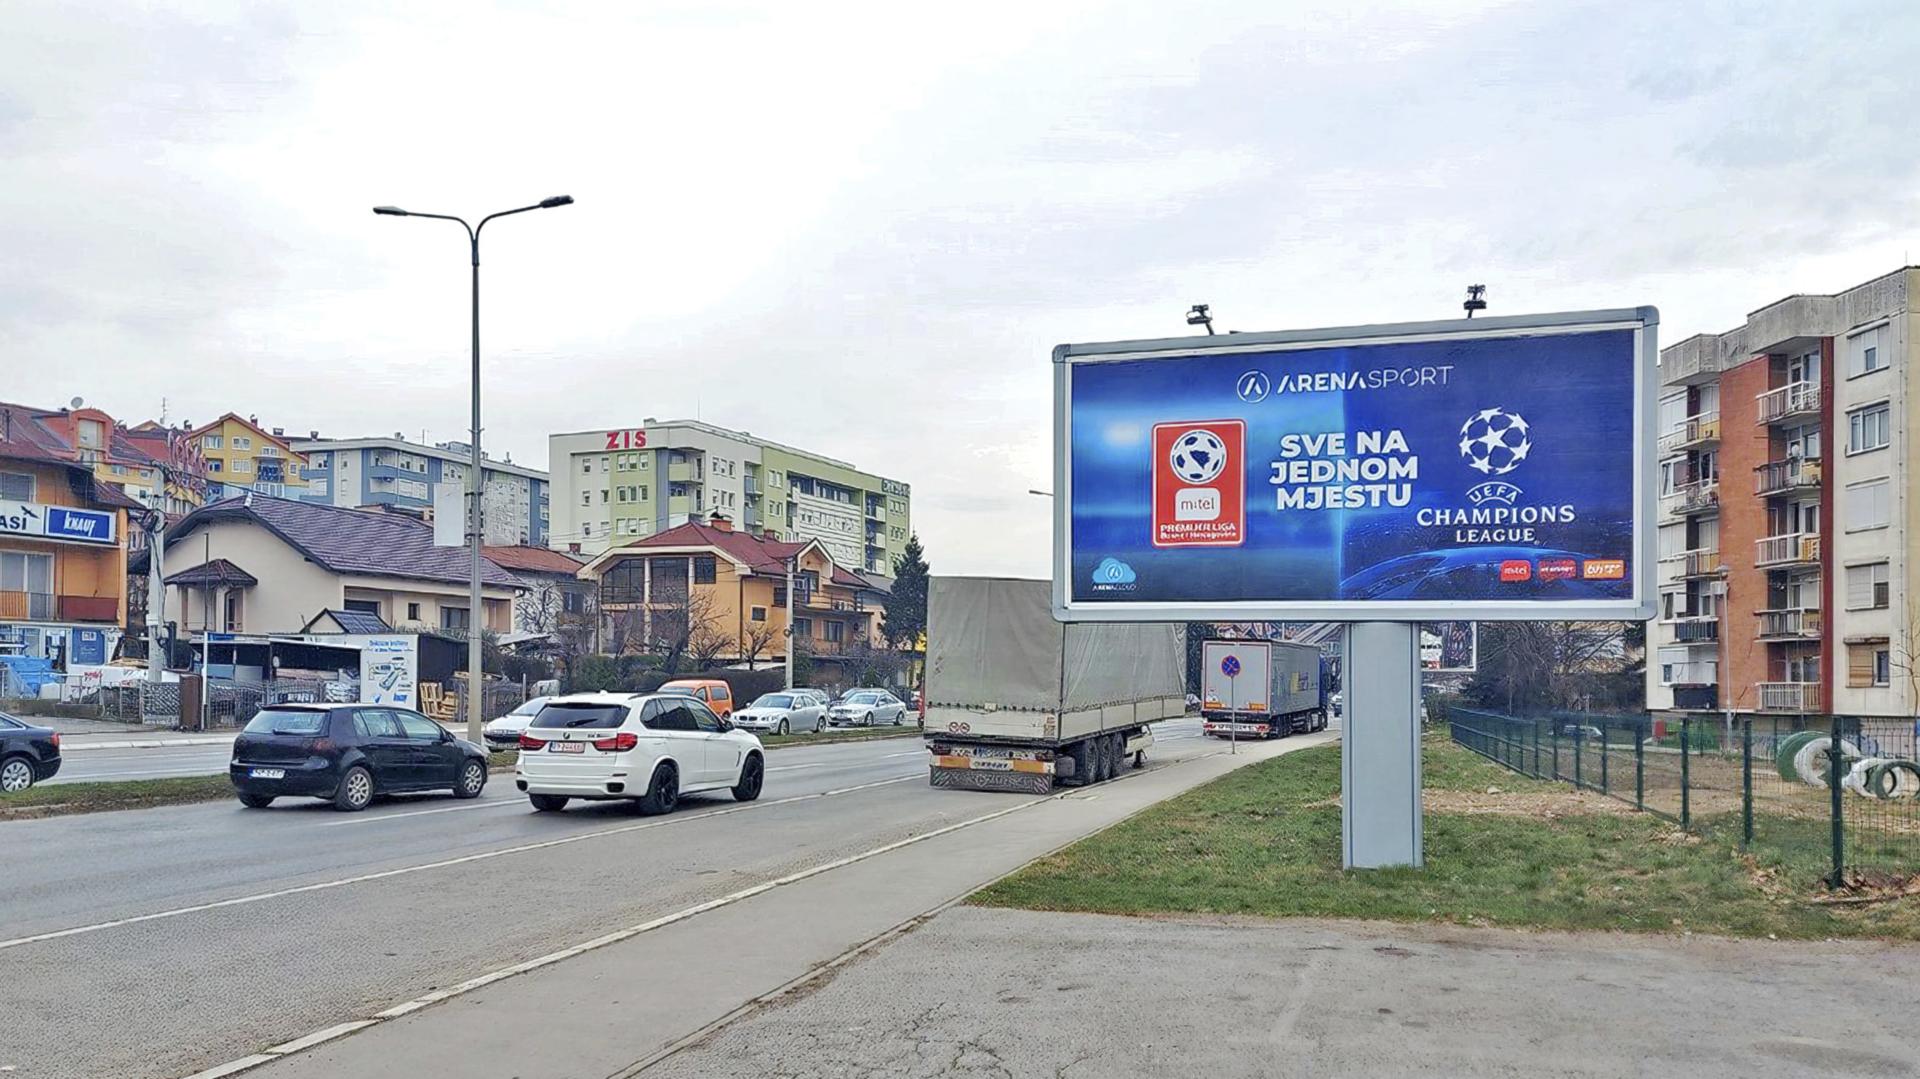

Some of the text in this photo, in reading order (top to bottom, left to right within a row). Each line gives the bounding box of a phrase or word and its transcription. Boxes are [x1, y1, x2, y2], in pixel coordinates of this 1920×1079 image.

[606, 430, 647, 449] ZIS
[1280, 430, 1410, 458] SVE NA
[1269, 456, 1418, 485] JEDNOM
[1276, 483, 1412, 511] MJESTU
[1469, 485, 1519, 502] UEFA
[1416, 504, 1576, 526] CHAMPIONS
[1456, 528, 1536, 543] LEAGUE
